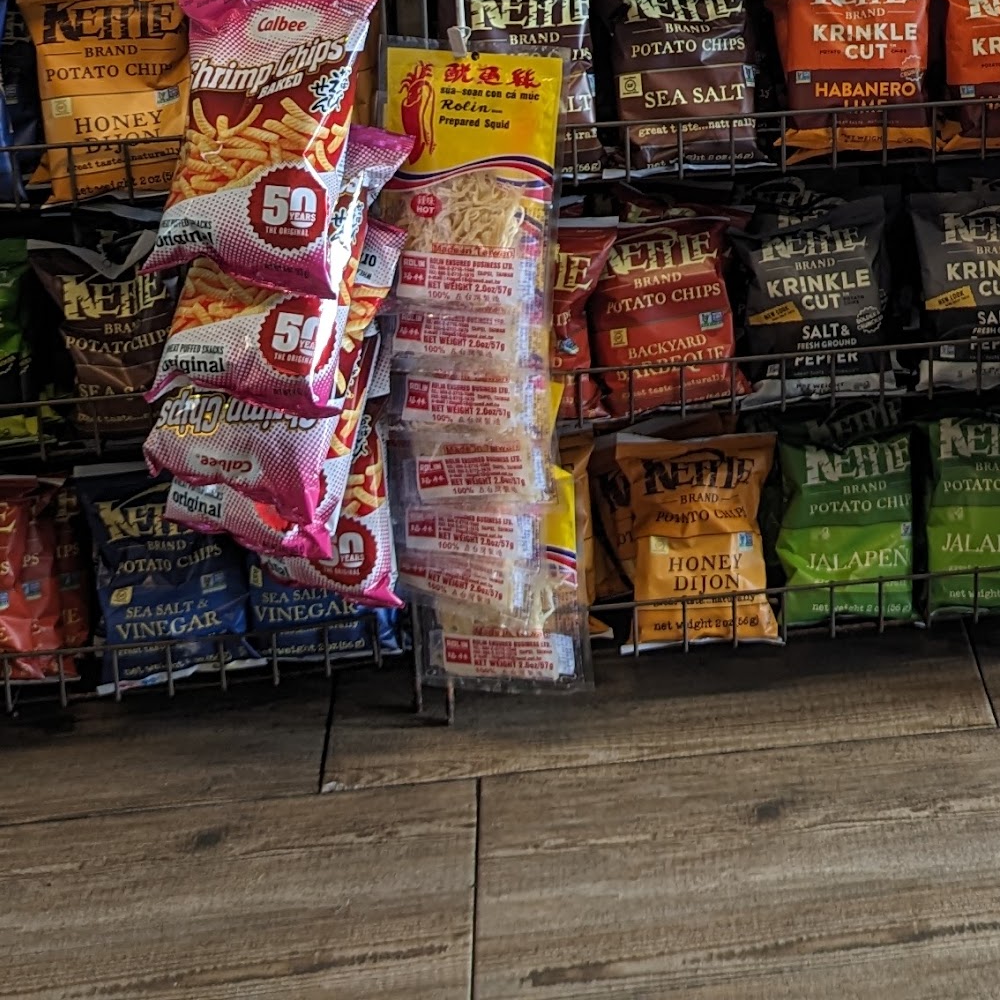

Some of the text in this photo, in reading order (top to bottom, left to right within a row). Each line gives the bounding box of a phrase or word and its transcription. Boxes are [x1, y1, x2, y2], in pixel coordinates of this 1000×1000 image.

[845, 7, 885, 20] BRAND
[258, 15, 307, 32] Calbee
[813, 23, 918, 41] KRINKLE
[509, 32, 560, 45] BRAND
[631, 37, 746, 57] POTATO CHIPS
[84, 45, 138, 58] BRAND
[276, 37, 347, 76] Chips
[844, 43, 887, 60] CUT
[46, 63, 119, 83] POTATO
[258, 73, 304, 99] BAKED
[815, 81, 916, 98] HABANERO
[645, 82, 746, 108] SEA SALT
[440, 99, 490, 113] Rolin
[75, 109, 163, 135] HONEY
[439, 115, 510, 130] Prepared Squid
[638, 123, 671, 137] great
[261, 185, 318, 228] 50
[416, 206, 435, 214] HOT
[289, 211, 316, 223] YEARS
[265, 226, 309, 237] THE ORIGINAL
[428, 281, 442, 289] NET
[444, 282, 472, 291] WEIGHT
[633, 271, 682, 289] BRAND
[766, 268, 871, 298] KRINKLE
[671, 282, 721, 303] CHIPS
[801, 294, 841, 311] CUT
[802, 324, 851, 341] SALT &
[628, 333, 707, 360] BACKYARD
[821, 337, 857, 348] GROUND
[201, 455, 253, 473] Calbee
[172, 490, 222, 518] original
[809, 499, 872, 515] POTATO
[668, 553, 743, 573] HONEY
[674, 573, 740, 595] DIJON
[261, 590, 289, 603] SEA
[151, 601, 195, 617] SALT
[254, 600, 357, 624] VINEGAR
[115, 609, 223, 643] VINEGAR
[653, 621, 673, 631] net
